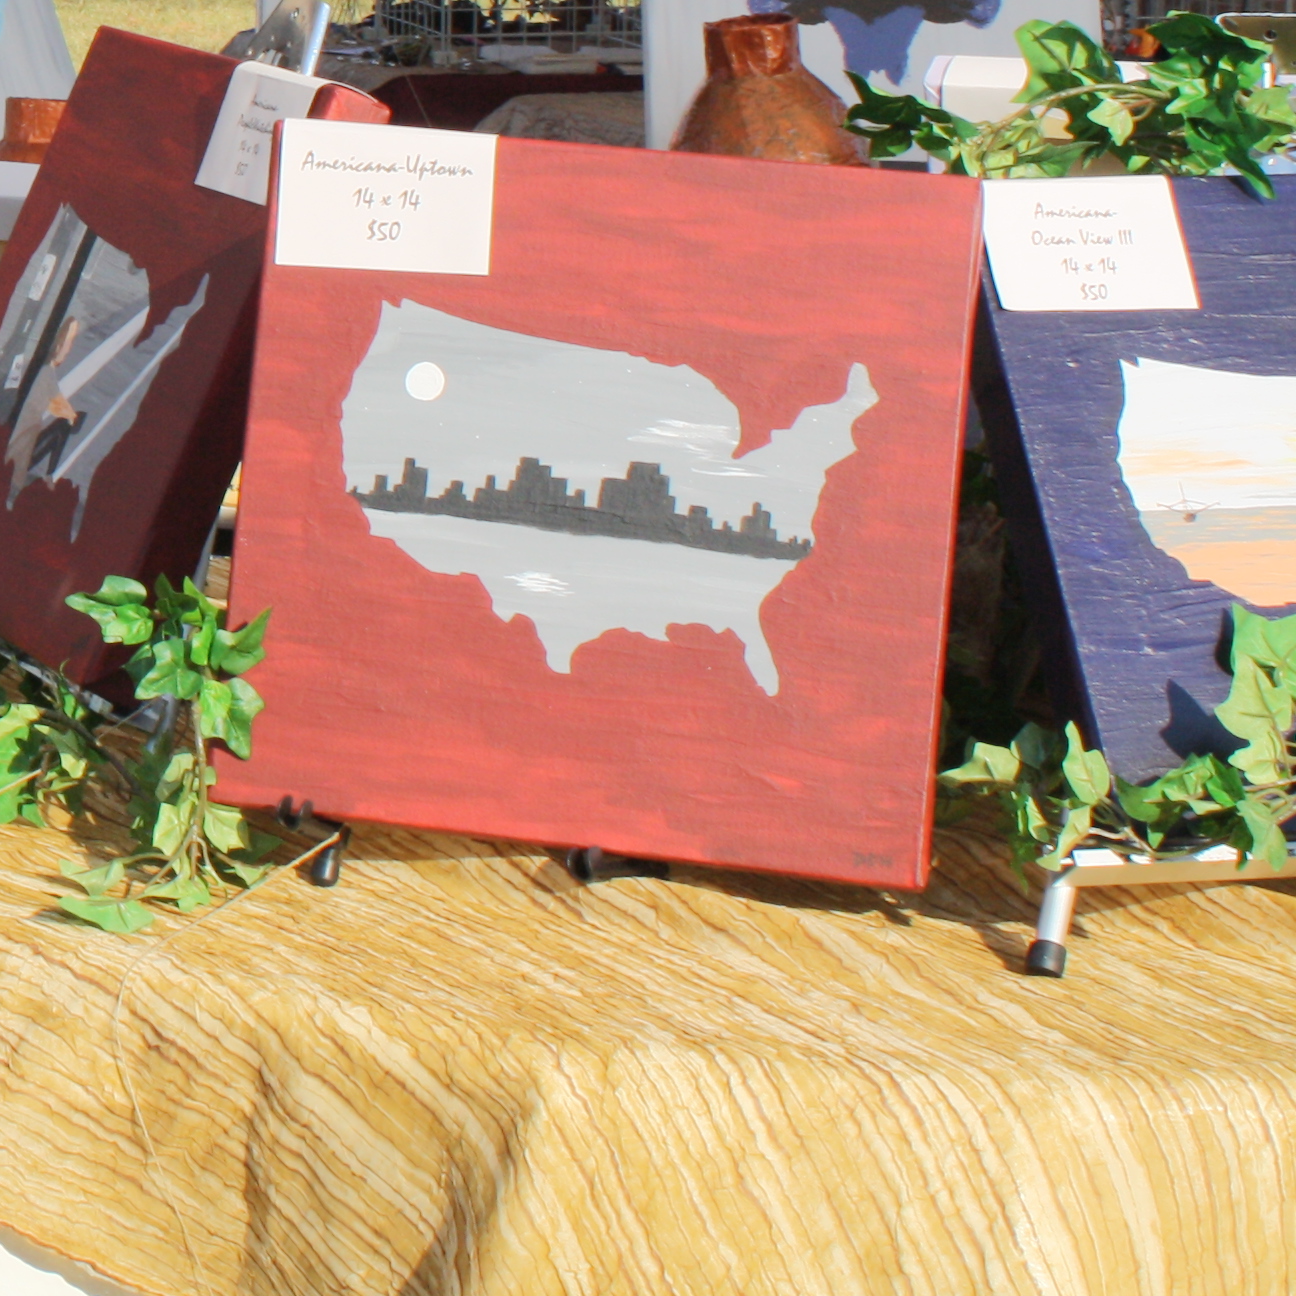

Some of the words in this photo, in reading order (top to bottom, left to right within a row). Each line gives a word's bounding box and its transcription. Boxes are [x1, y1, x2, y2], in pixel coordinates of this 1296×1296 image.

[352, 188, 375, 209] 14
[380, 194, 392, 206] x
[398, 188, 421, 211] 14
[366, 218, 402, 242] $50
[1031, 230, 1076, 246] Ocean
[1078, 229, 1113, 245] View
[1061, 258, 1079, 275] 14
[1084, 264, 1094, 273] x
[1099, 257, 1117, 274] 14
[1079, 283, 1108, 301] $50
